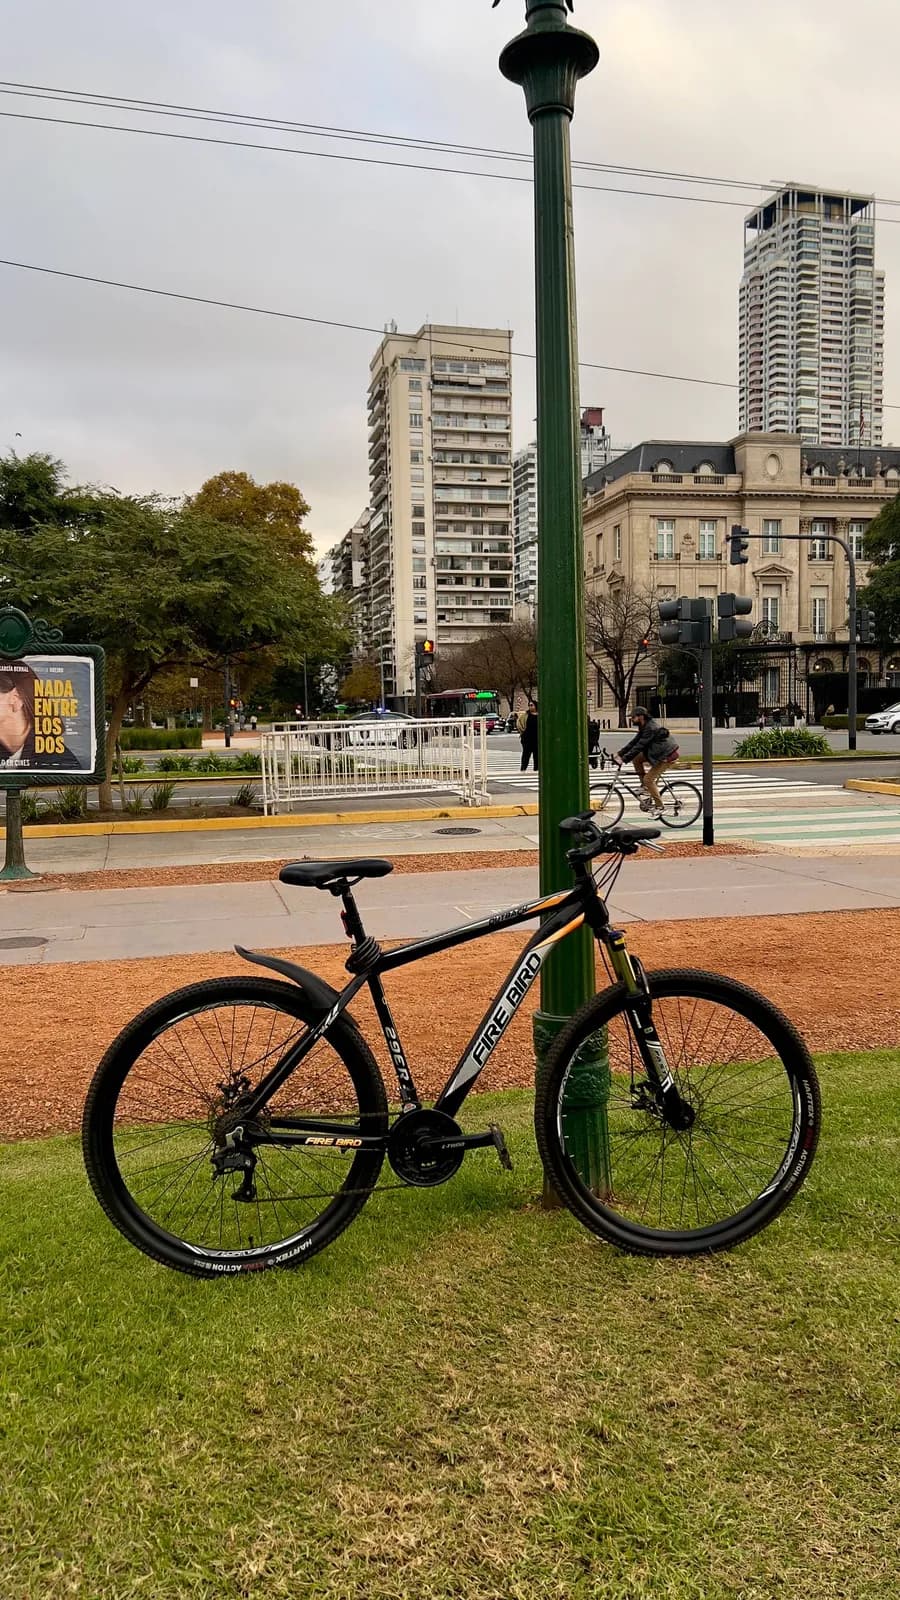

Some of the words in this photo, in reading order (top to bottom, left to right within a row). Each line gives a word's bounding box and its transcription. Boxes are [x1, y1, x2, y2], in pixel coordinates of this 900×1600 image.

[34, 679, 74, 697] NADA
[34, 698, 78, 717] ENTRE
[34, 717, 63, 736] LOS
[35, 736, 65, 754] DOS
[472, 1005, 509, 1067] FIRE
[506, 952, 542, 1008] BIRD
[384, 1026, 410, 1081] 29ER
[802, 1079, 815, 1119] HARTEX
[305, 1137, 335, 1146] FIRE
[335, 1138, 363, 1147] BIRD
[793, 1149, 808, 1177] ACTION
[275, 1238, 313, 1263] HARTEX
[212, 1264, 242, 1272] ACTION
